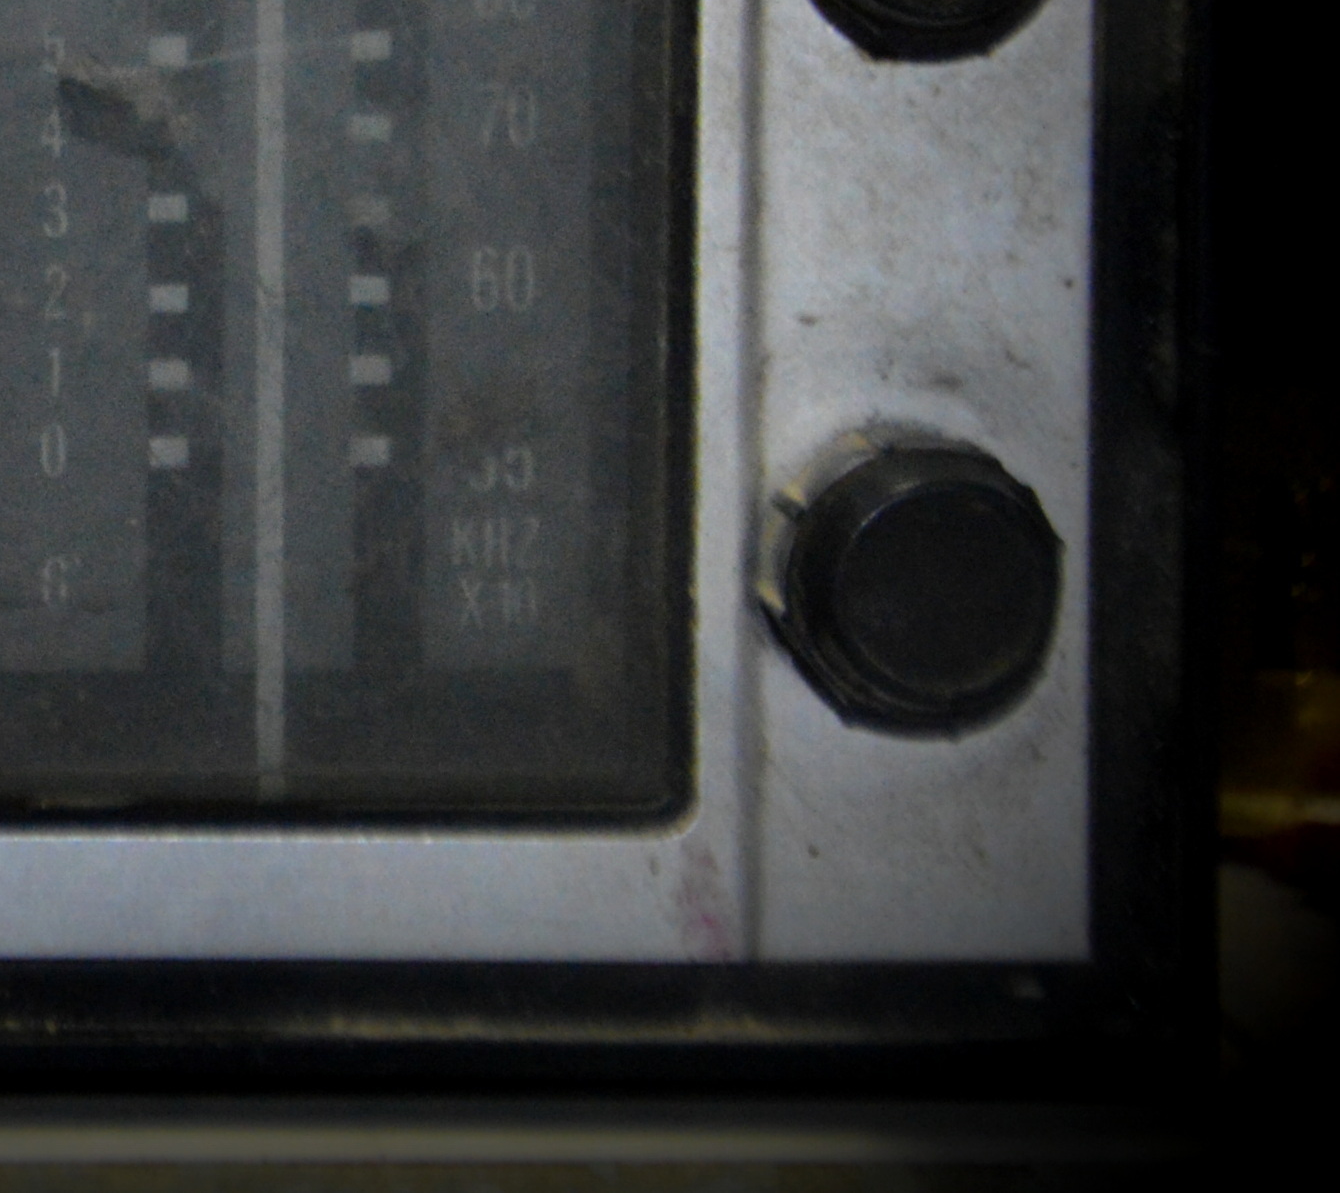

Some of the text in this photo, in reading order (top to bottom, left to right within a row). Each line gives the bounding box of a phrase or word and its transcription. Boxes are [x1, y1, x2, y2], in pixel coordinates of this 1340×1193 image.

[480, 82, 539, 151] 70
[40, 179, 69, 240] 3
[41, 263, 71, 324] 2
[469, 243, 537, 313] 60
[39, 421, 68, 481] 0
